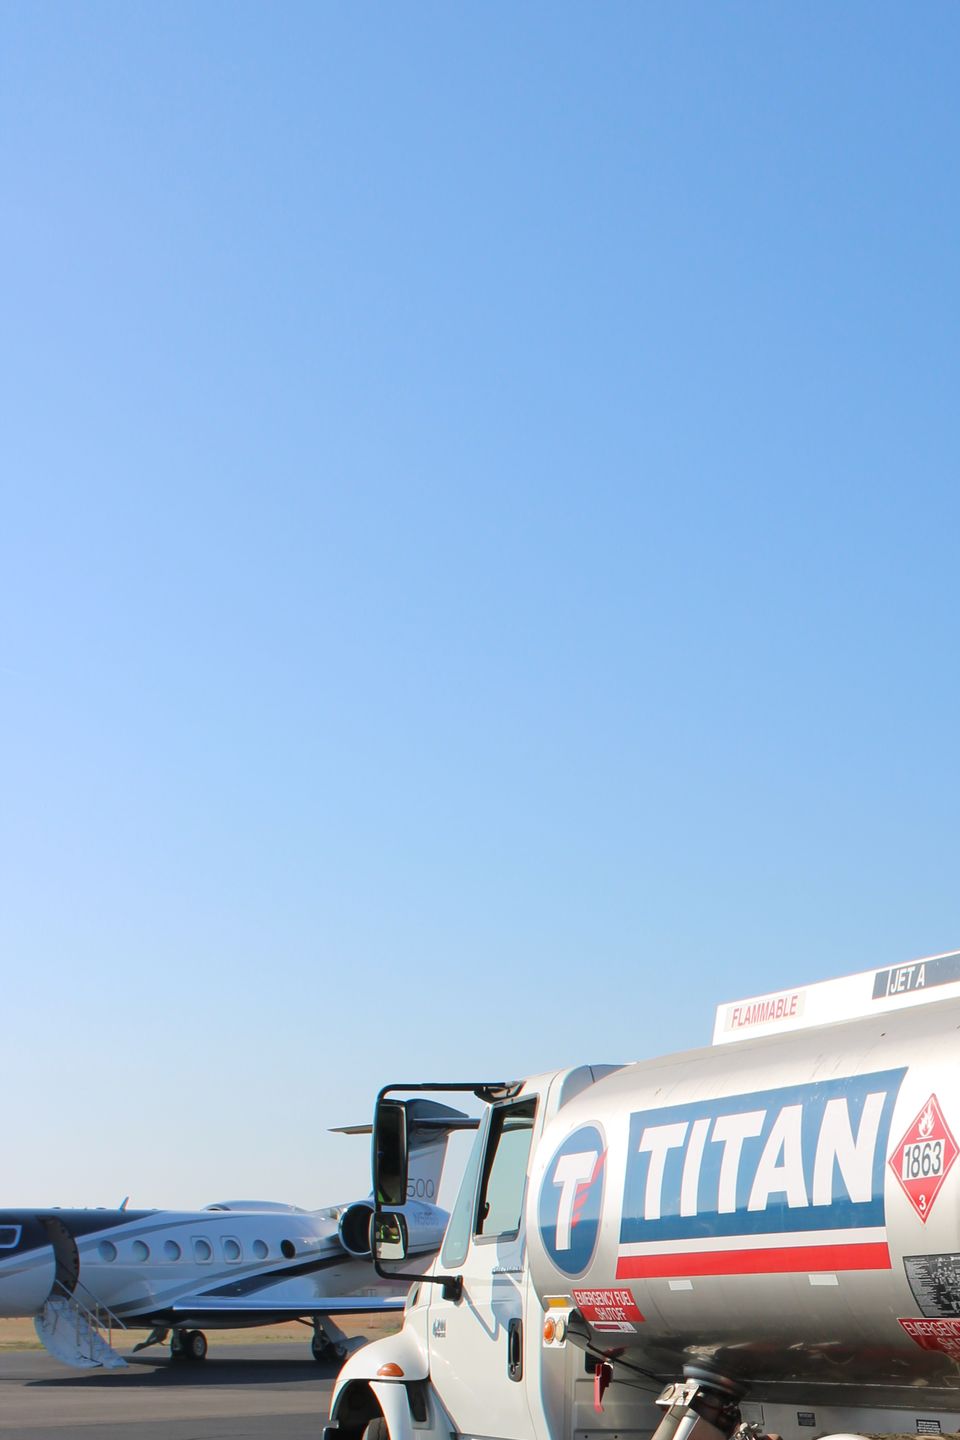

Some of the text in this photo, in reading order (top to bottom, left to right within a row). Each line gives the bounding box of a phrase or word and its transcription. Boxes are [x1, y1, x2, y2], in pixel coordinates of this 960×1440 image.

[890, 963, 926, 993] JET A
[731, 995, 798, 1029] FLAMMABLE
[638, 1091, 887, 1222] TITAN
[905, 1141, 942, 1178] 1863
[407, 1178, 435, 1198] 500
[918, 1194, 927, 1211] 3
[574, 1291, 635, 1306] EMERGENCY FUEL
[594, 1307, 627, 1321] SHUTOFF
